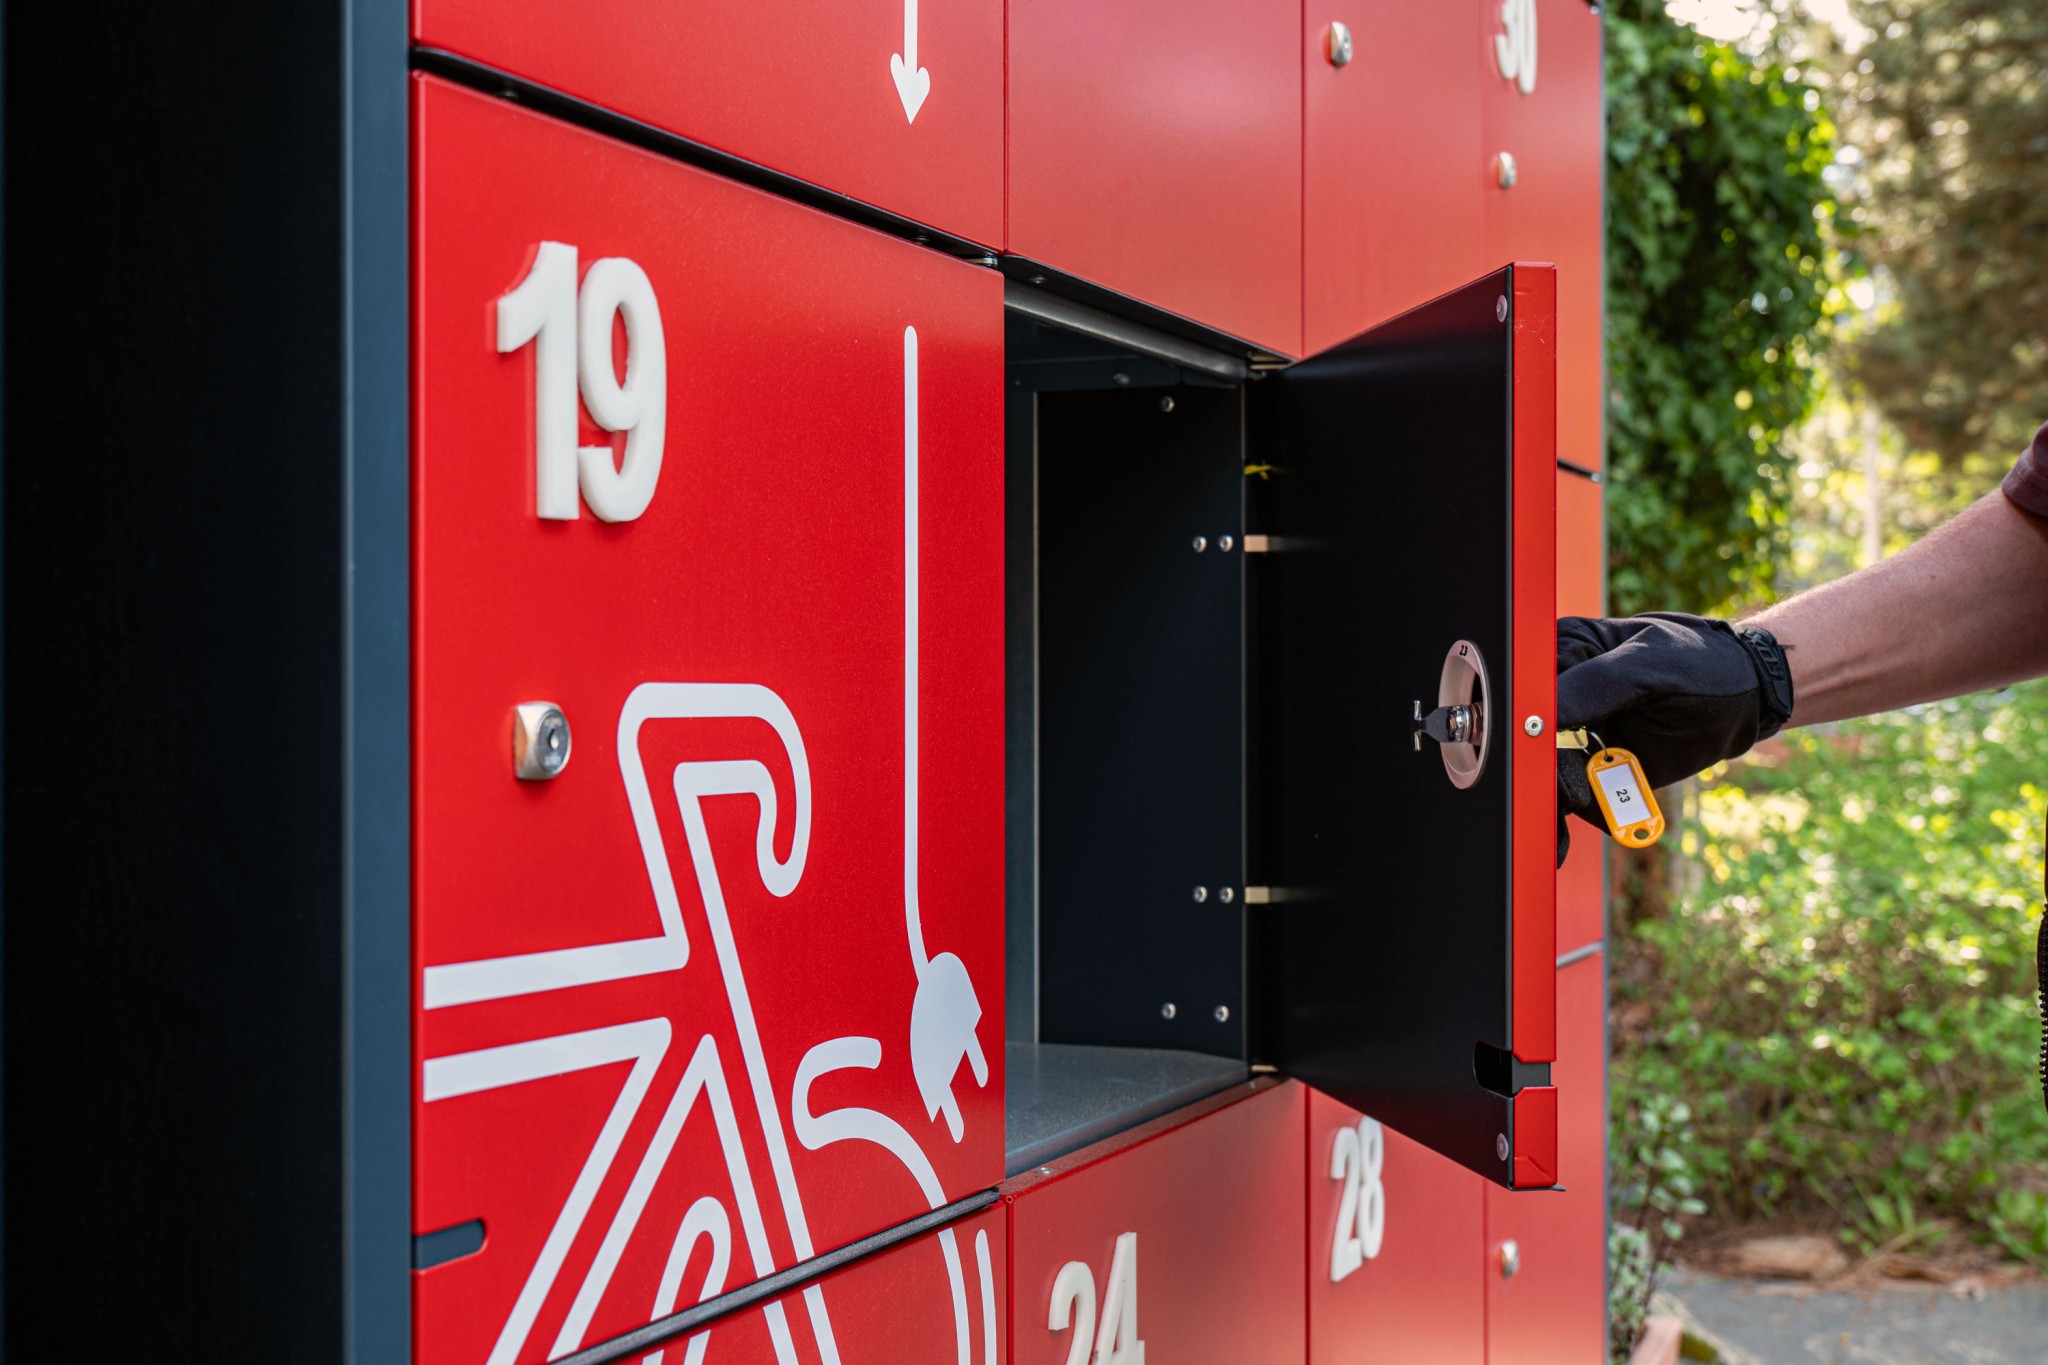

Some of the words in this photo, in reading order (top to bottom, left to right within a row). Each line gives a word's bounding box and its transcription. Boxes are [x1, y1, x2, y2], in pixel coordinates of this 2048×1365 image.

[1495, 0, 1538, 93] 30
[496, 241, 668, 522] 19
[1459, 644, 1468, 657] 23
[1616, 789, 1630, 803] 23
[1330, 1115, 1385, 1282] 28
[1048, 1232, 1145, 1365] 24
